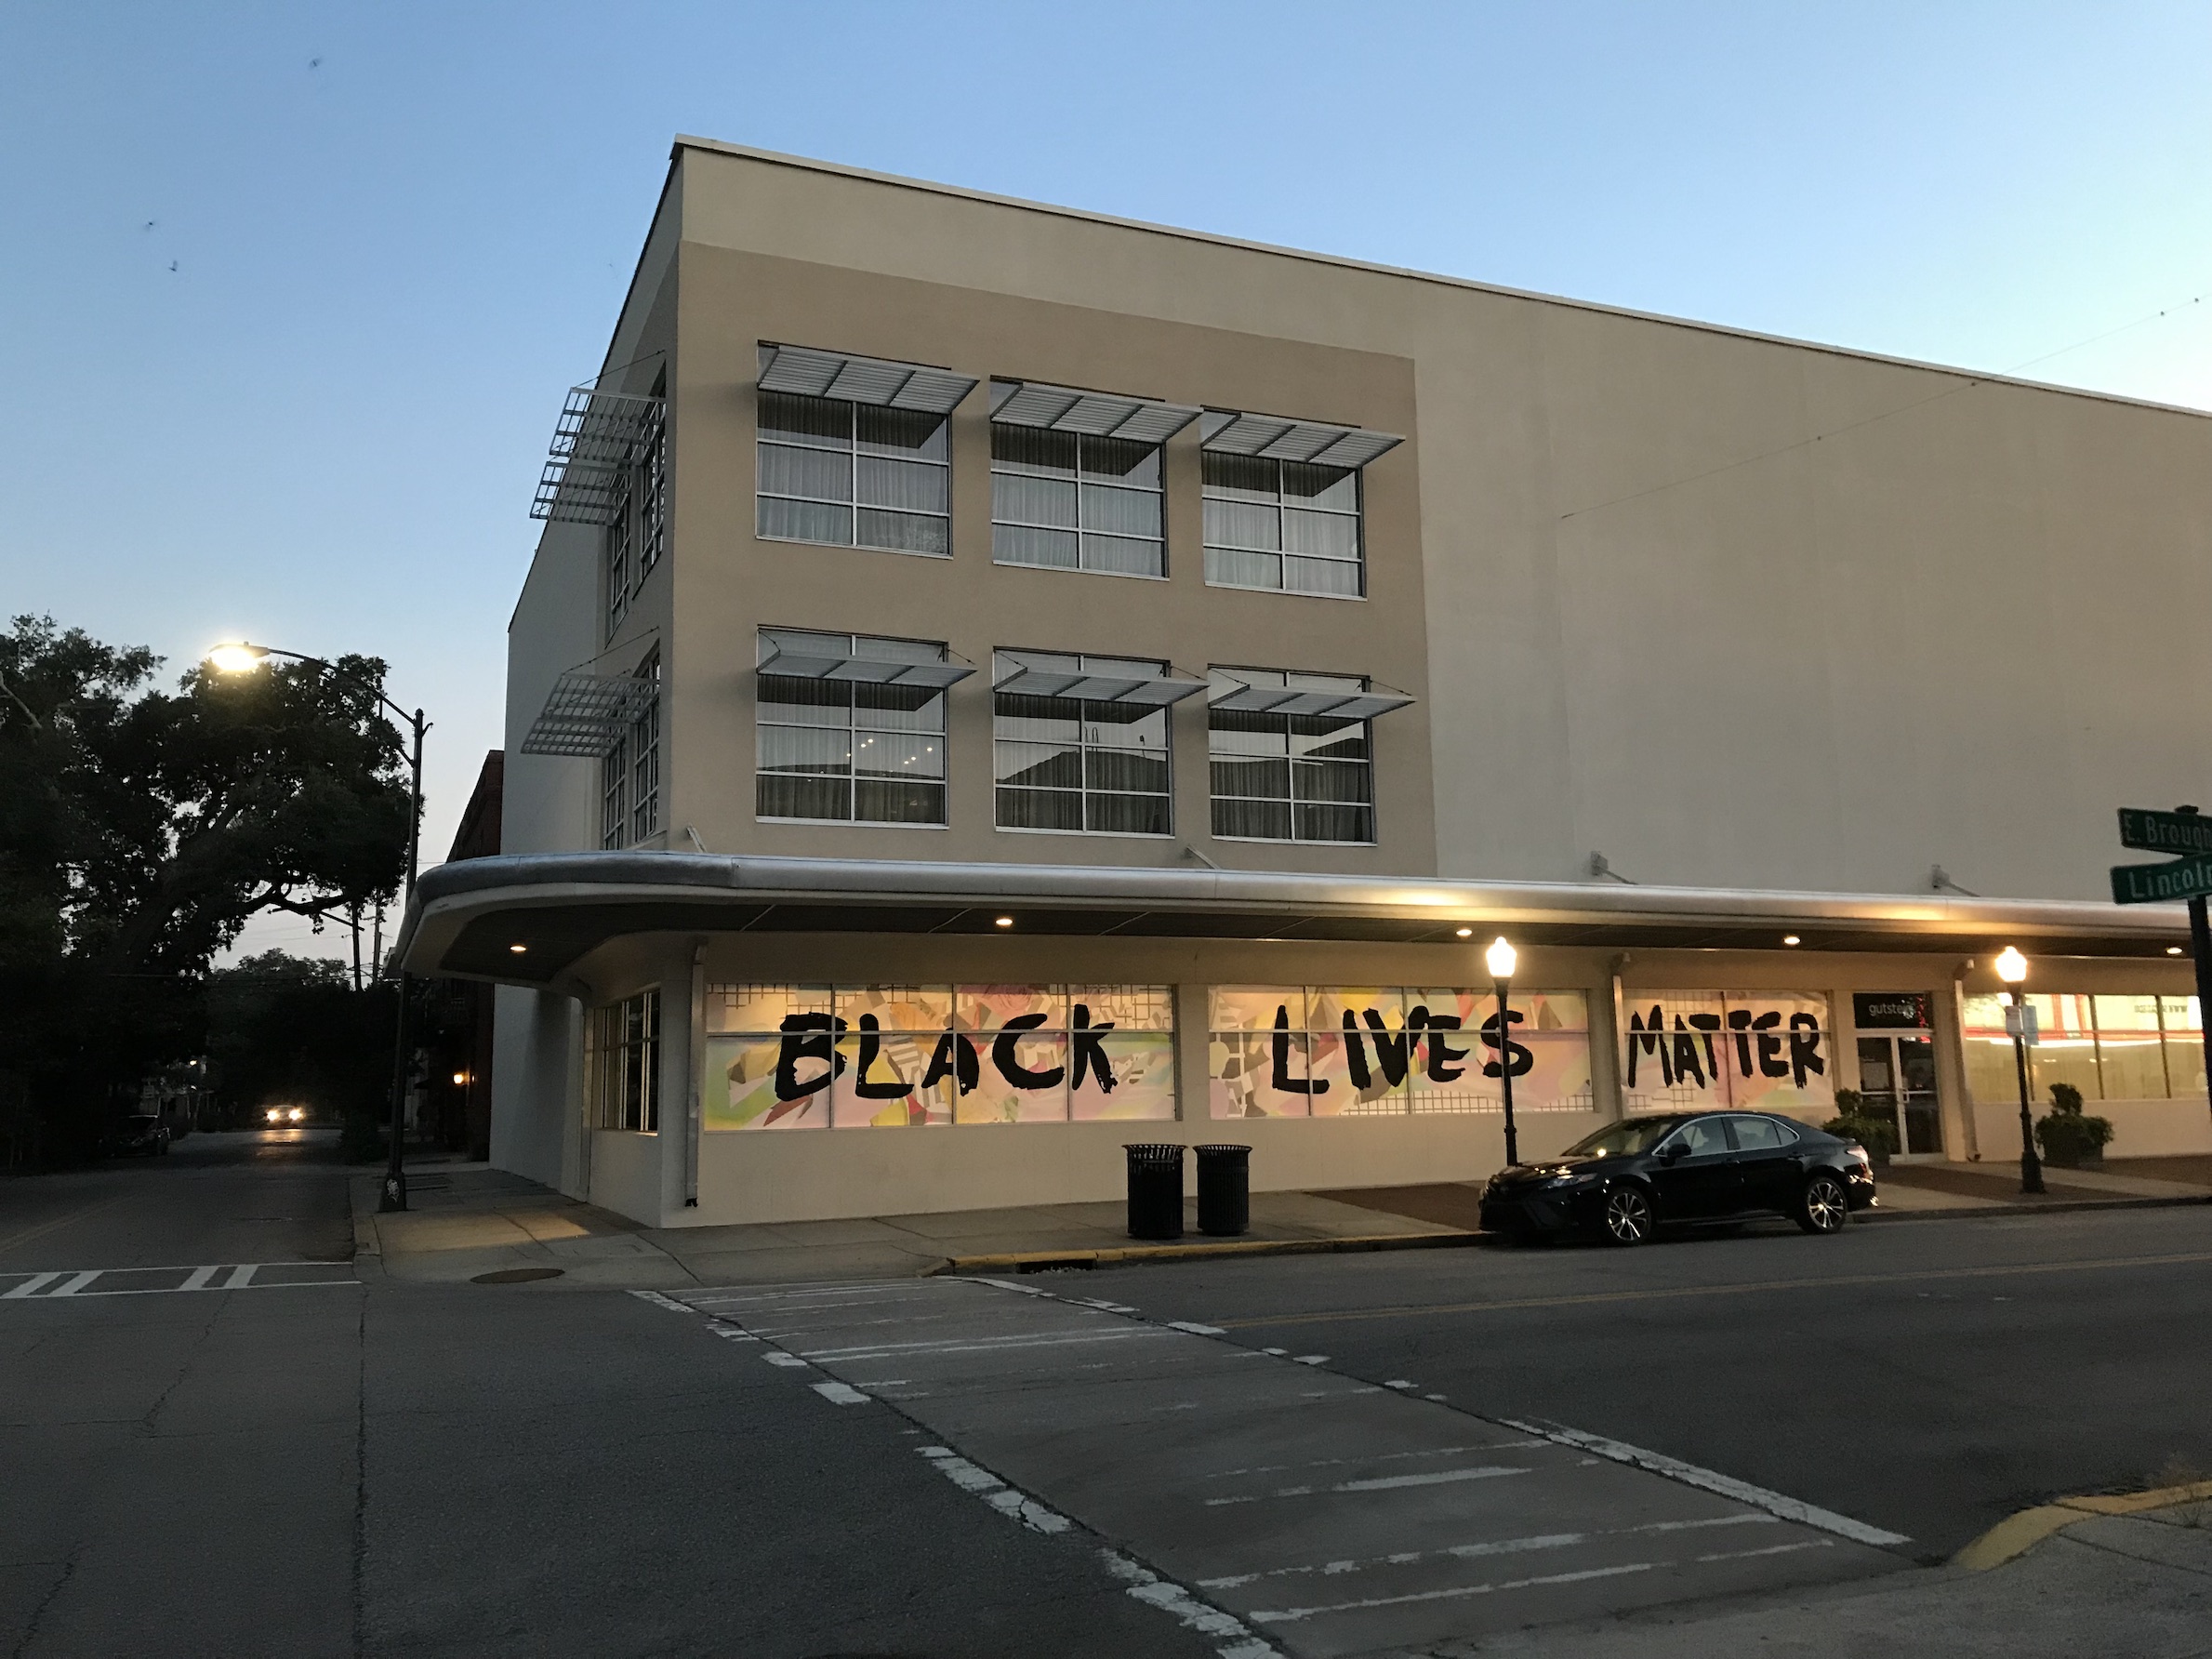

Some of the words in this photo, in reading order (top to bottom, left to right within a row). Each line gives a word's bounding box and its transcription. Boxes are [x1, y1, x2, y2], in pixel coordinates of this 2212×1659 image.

[775, 1003, 1119, 1102] BLACK
[1272, 1004, 1533, 1095] LIVES
[1628, 1004, 1824, 1089] MATTER
